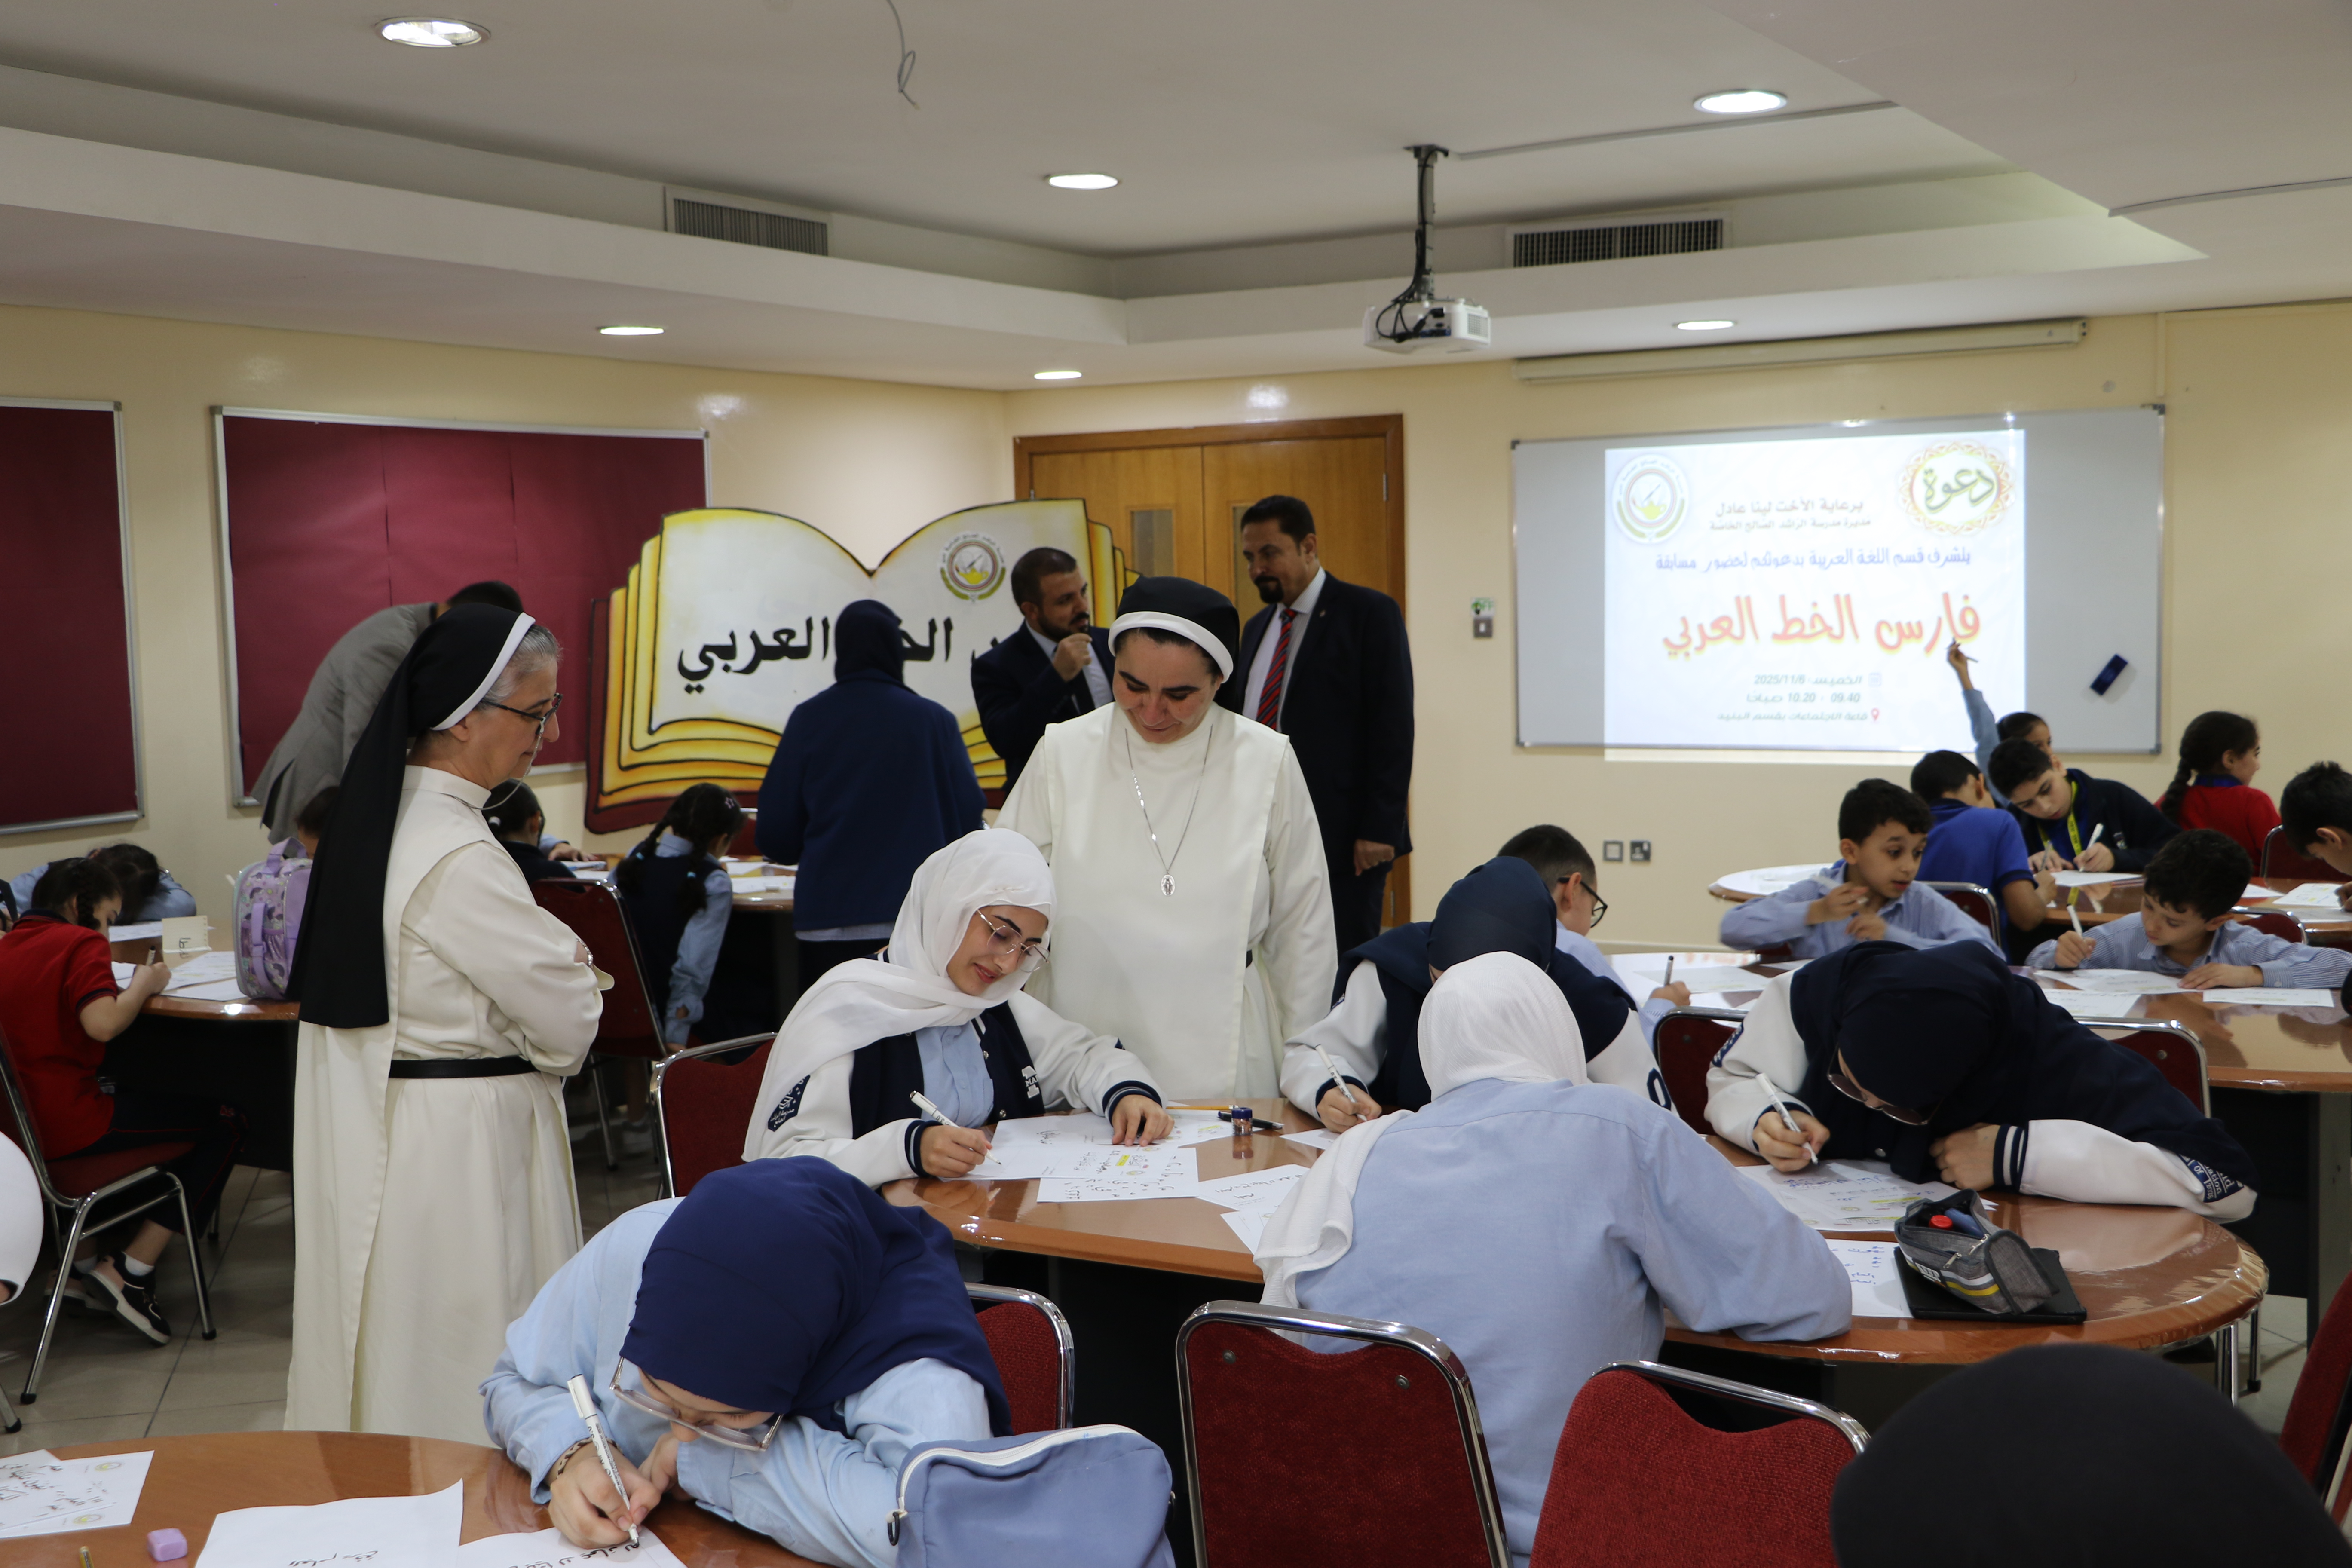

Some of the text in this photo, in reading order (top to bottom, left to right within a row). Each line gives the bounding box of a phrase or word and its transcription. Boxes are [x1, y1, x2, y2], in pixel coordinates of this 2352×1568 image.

[1923, 468, 1995, 513] دعوة
[1717, 502, 1745, 516] عادل
[1775, 496, 1814, 512] الأخت
[1820, 497, 1863, 513] برعاية
[1811, 518, 1840, 528] مدرسة
[1655, 553, 1697, 570] مسابقة
[1702, 551, 1748, 573] لحضور
[1808, 548, 1852, 570] العربية
[1856, 548, 1890, 566] اللغة
[1892, 547, 1924, 567] قسم
[1663, 592, 1980, 660] فارس الخط العربي
[678, 616, 830, 694] العربي
[1787, 692, 1816, 703] 10.20
[1830, 692, 1860, 703] 09.40
